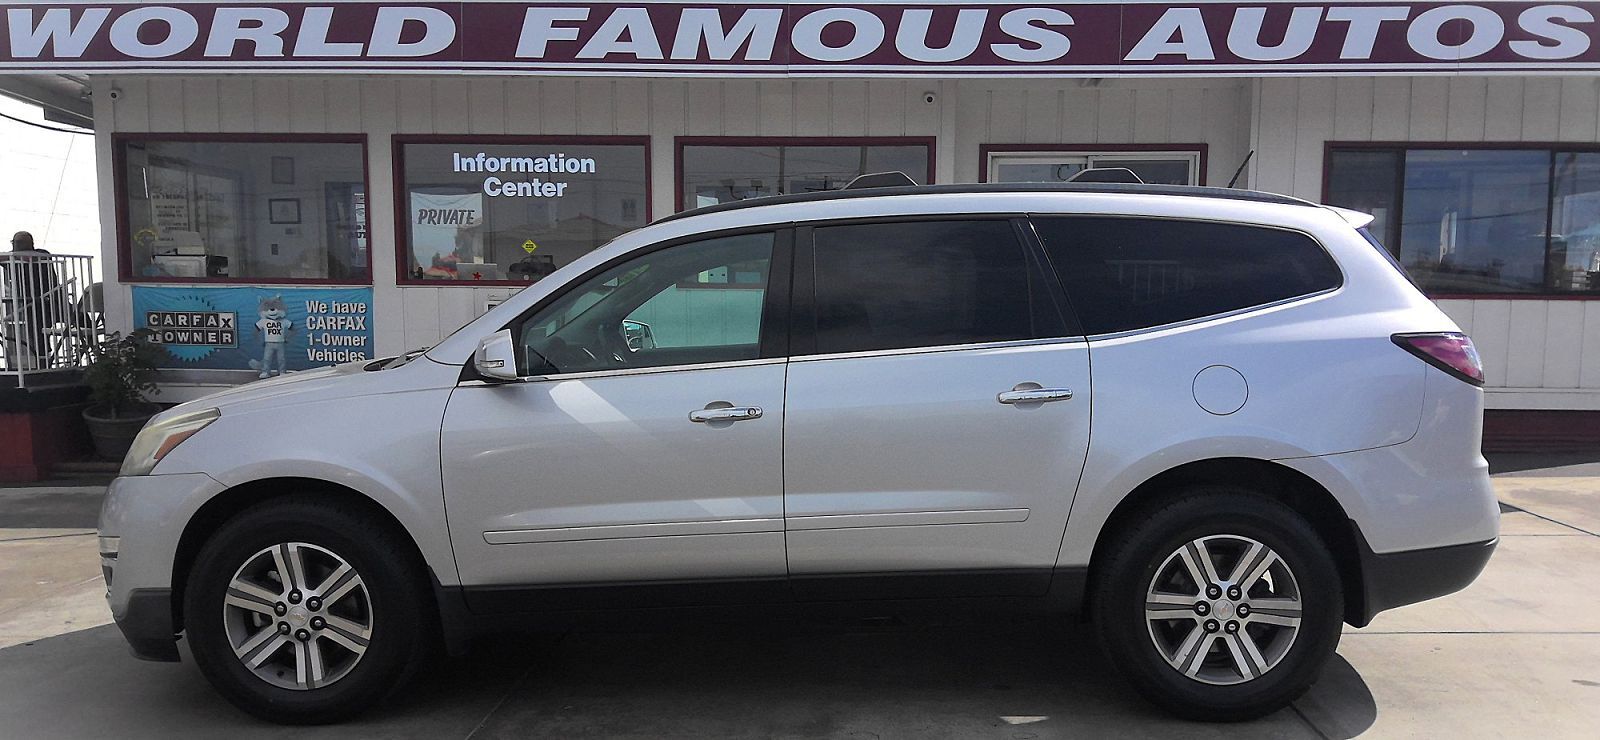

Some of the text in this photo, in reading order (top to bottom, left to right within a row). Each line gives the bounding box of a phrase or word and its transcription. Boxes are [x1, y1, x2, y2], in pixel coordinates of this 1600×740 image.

[6, 5, 1596, 62] WORLD FAMOUS AUTOS
[453, 152, 596, 174] Information
[483, 177, 568, 198] Center
[417, 208, 476, 226] PRIVATE
[305, 300, 367, 314] We have
[149, 314, 233, 329] CARFAX
[266, 321, 282, 329] CAR
[305, 315, 366, 331] CARFAX
[164, 331, 233, 344] OWNER
[306, 332, 367, 347] 1-Owner
[306, 348, 366, 362] Vehicles
